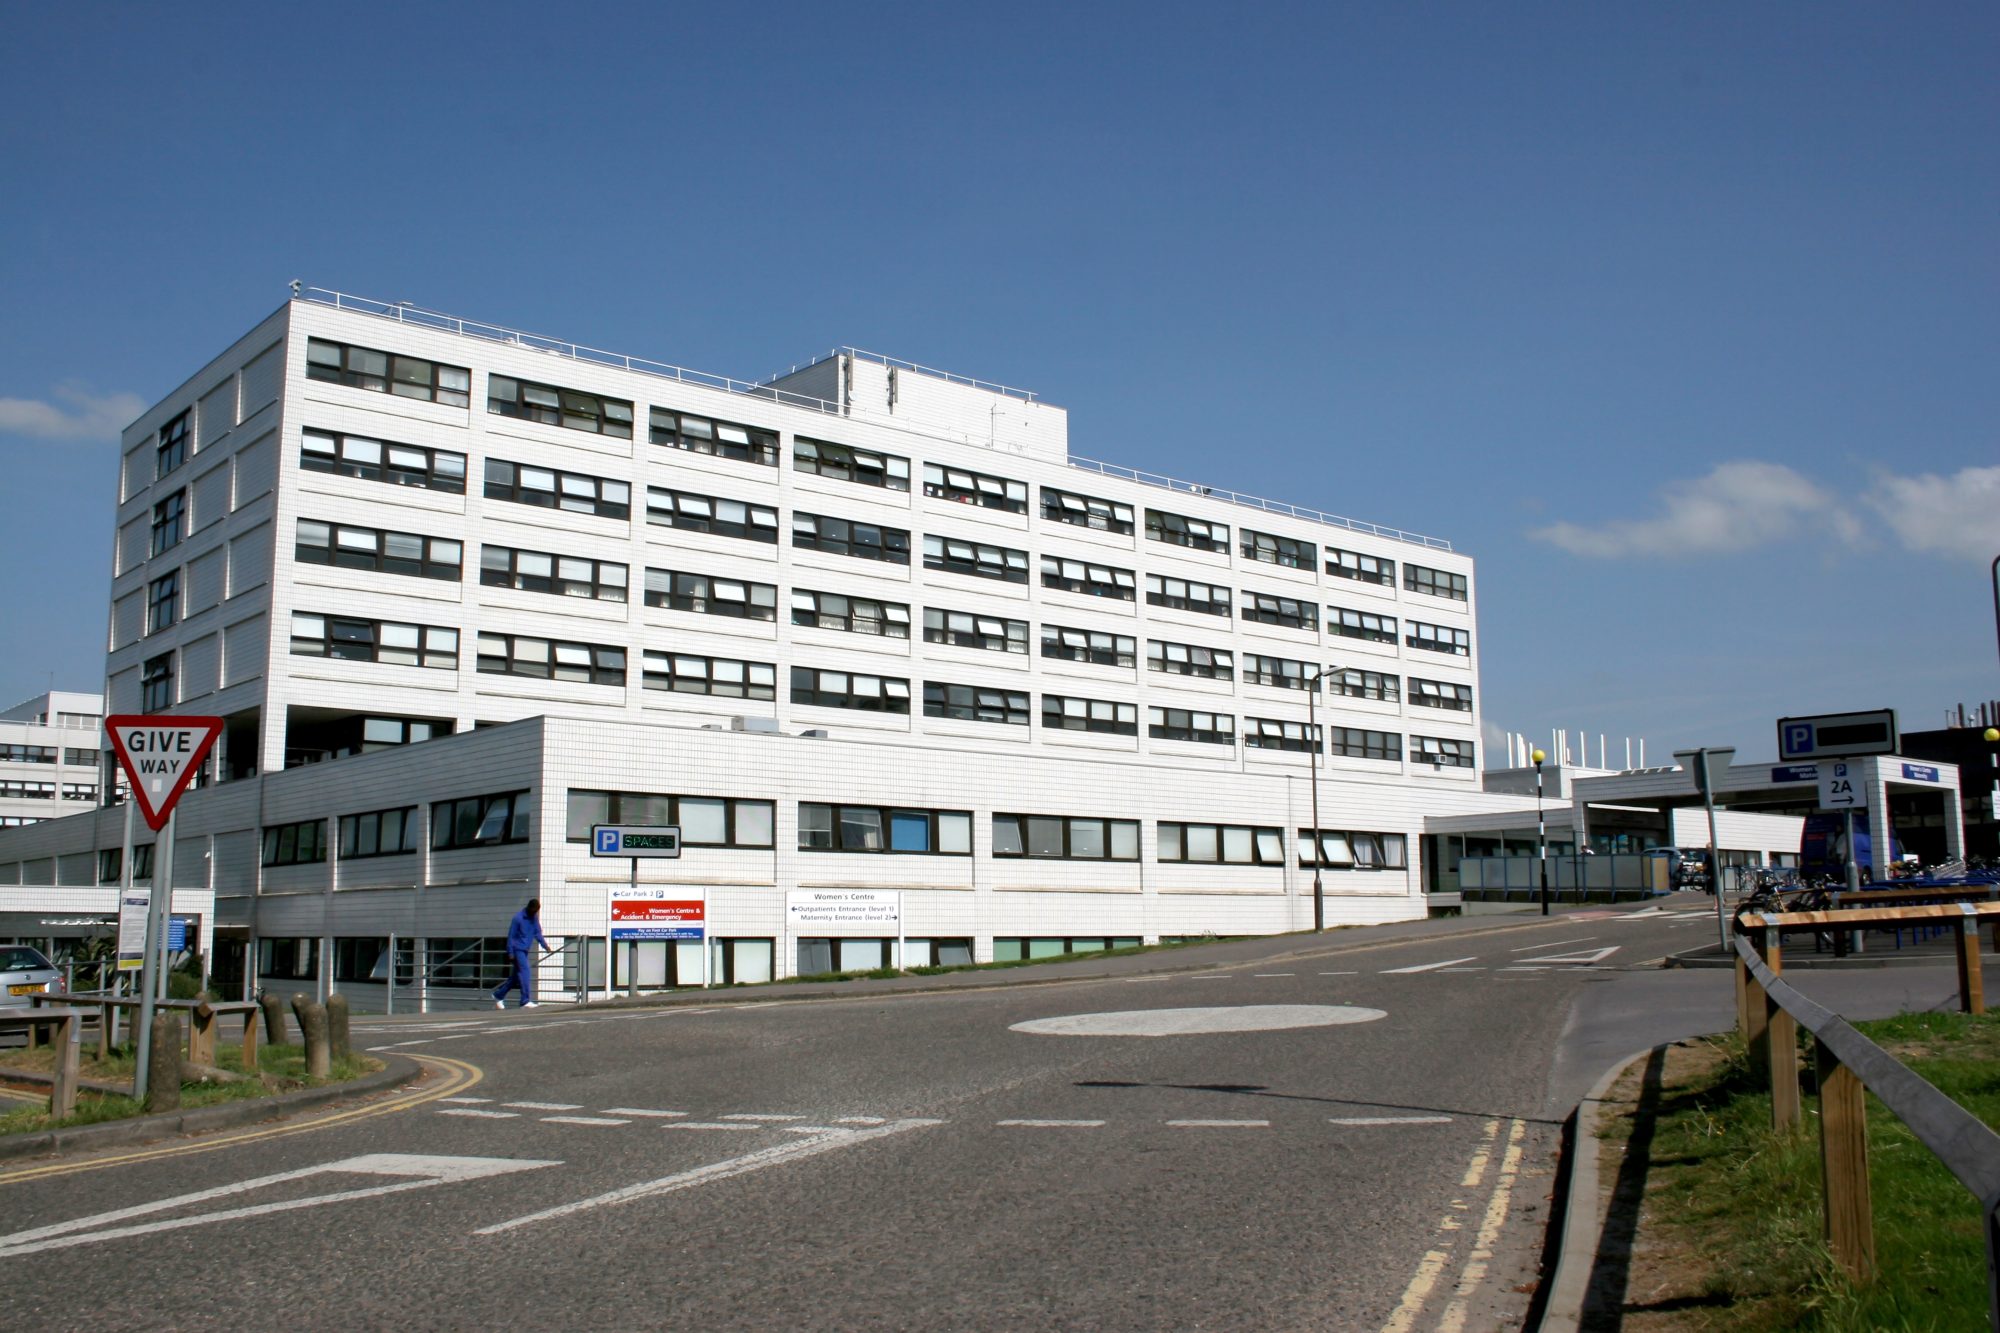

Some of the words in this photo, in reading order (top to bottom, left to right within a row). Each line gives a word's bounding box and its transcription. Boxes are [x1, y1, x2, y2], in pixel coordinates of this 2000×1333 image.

[128, 731, 191, 752] GIVE
[1791, 727, 1809, 751] P
[141, 760, 180, 774] WAY
[1831, 780, 1853, 794] 2A
[602, 832, 617, 851] P
[624, 835, 674, 848] SPACES
